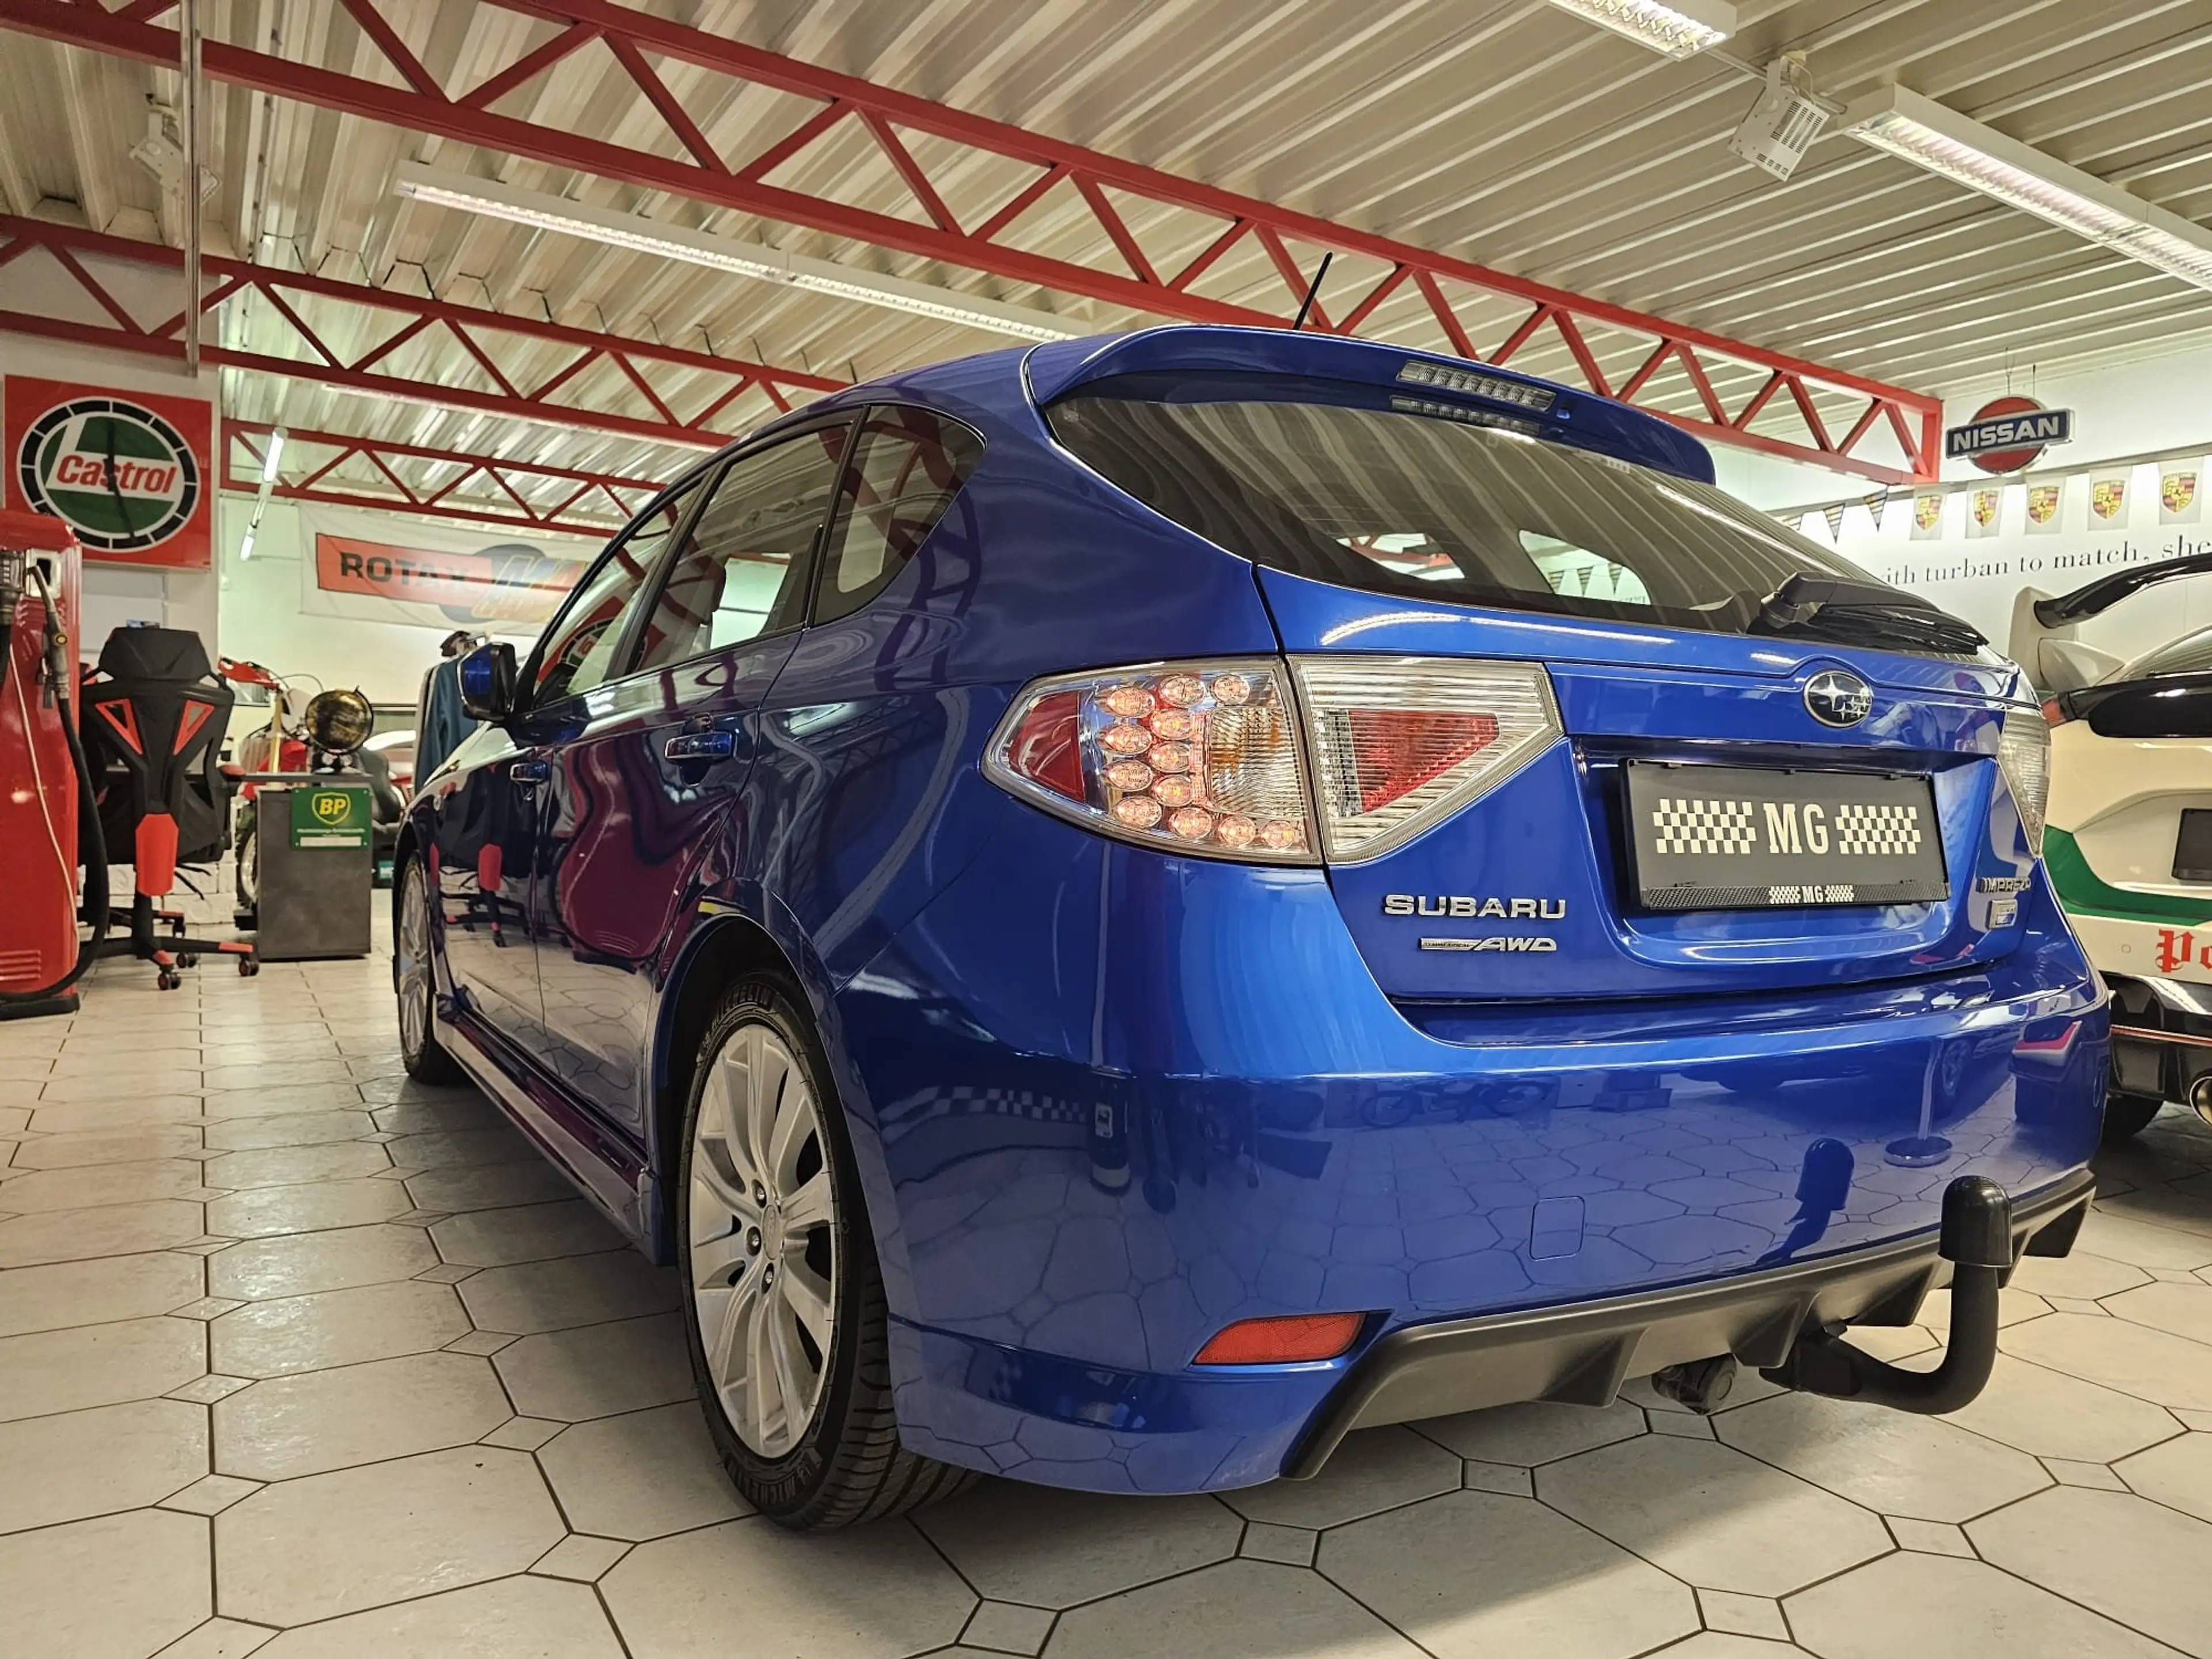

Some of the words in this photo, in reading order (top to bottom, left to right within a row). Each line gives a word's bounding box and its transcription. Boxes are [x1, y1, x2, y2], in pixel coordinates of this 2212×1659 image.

[1953, 416, 2059, 452] NISSAN
[56, 454, 177, 494] Castrol
[1885, 564, 1915, 585] ith
[1926, 557, 2008, 582] turban
[2020, 557, 2042, 573] to
[2054, 540, 2150, 569] match,
[319, 798, 347, 815] BP
[1763, 803, 1830, 854] MG
[1384, 894, 1566, 919] SUBARU
[1801, 885, 1824, 903] MG
[1474, 937, 1558, 952] AWD
